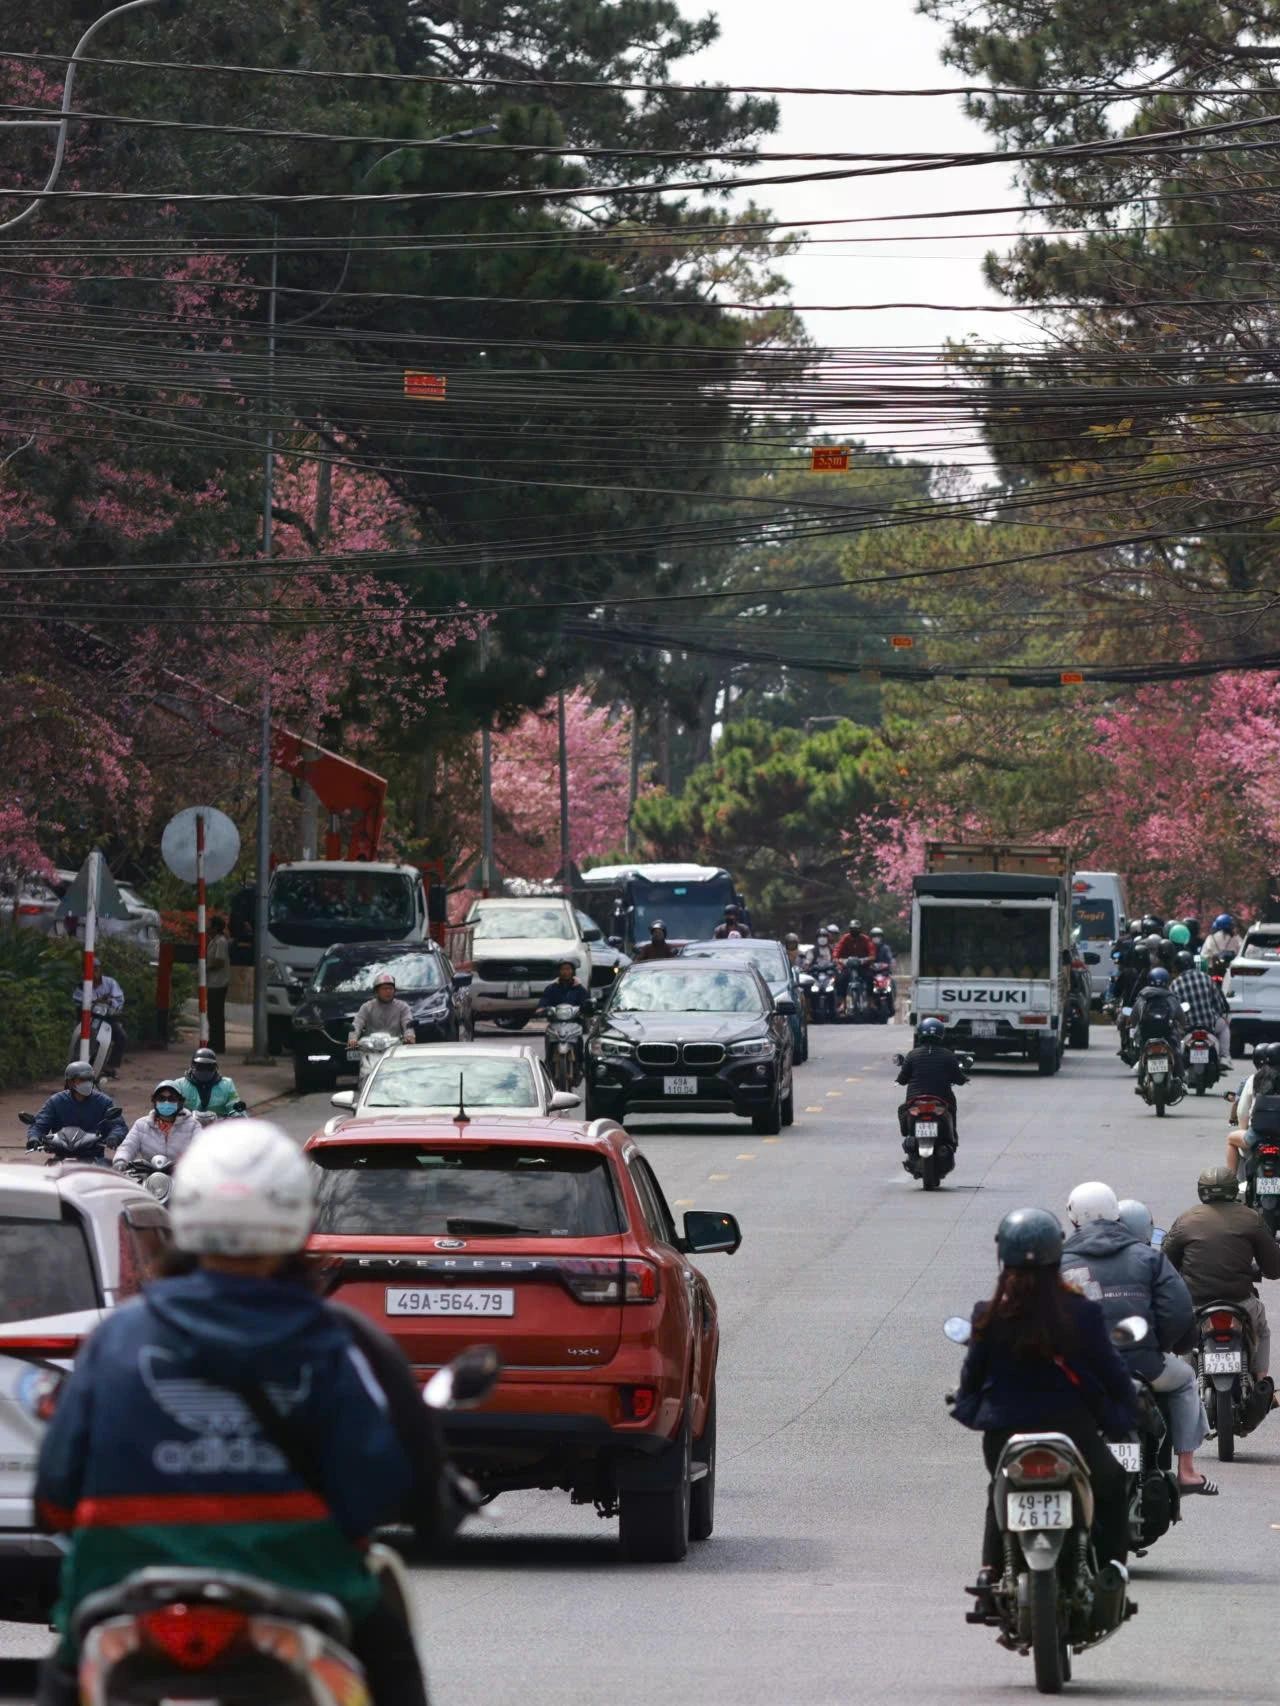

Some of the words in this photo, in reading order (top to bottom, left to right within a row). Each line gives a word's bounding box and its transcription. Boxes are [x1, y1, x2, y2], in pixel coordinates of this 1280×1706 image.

[942, 989, 1026, 1003] SUZUKI
[359, 1259, 541, 1268] EVEREST
[397, 1293, 503, 1311] 49A-564.79
[1018, 1494, 1060, 1509] 49-P1
[1018, 1511, 1062, 1526] 4612
